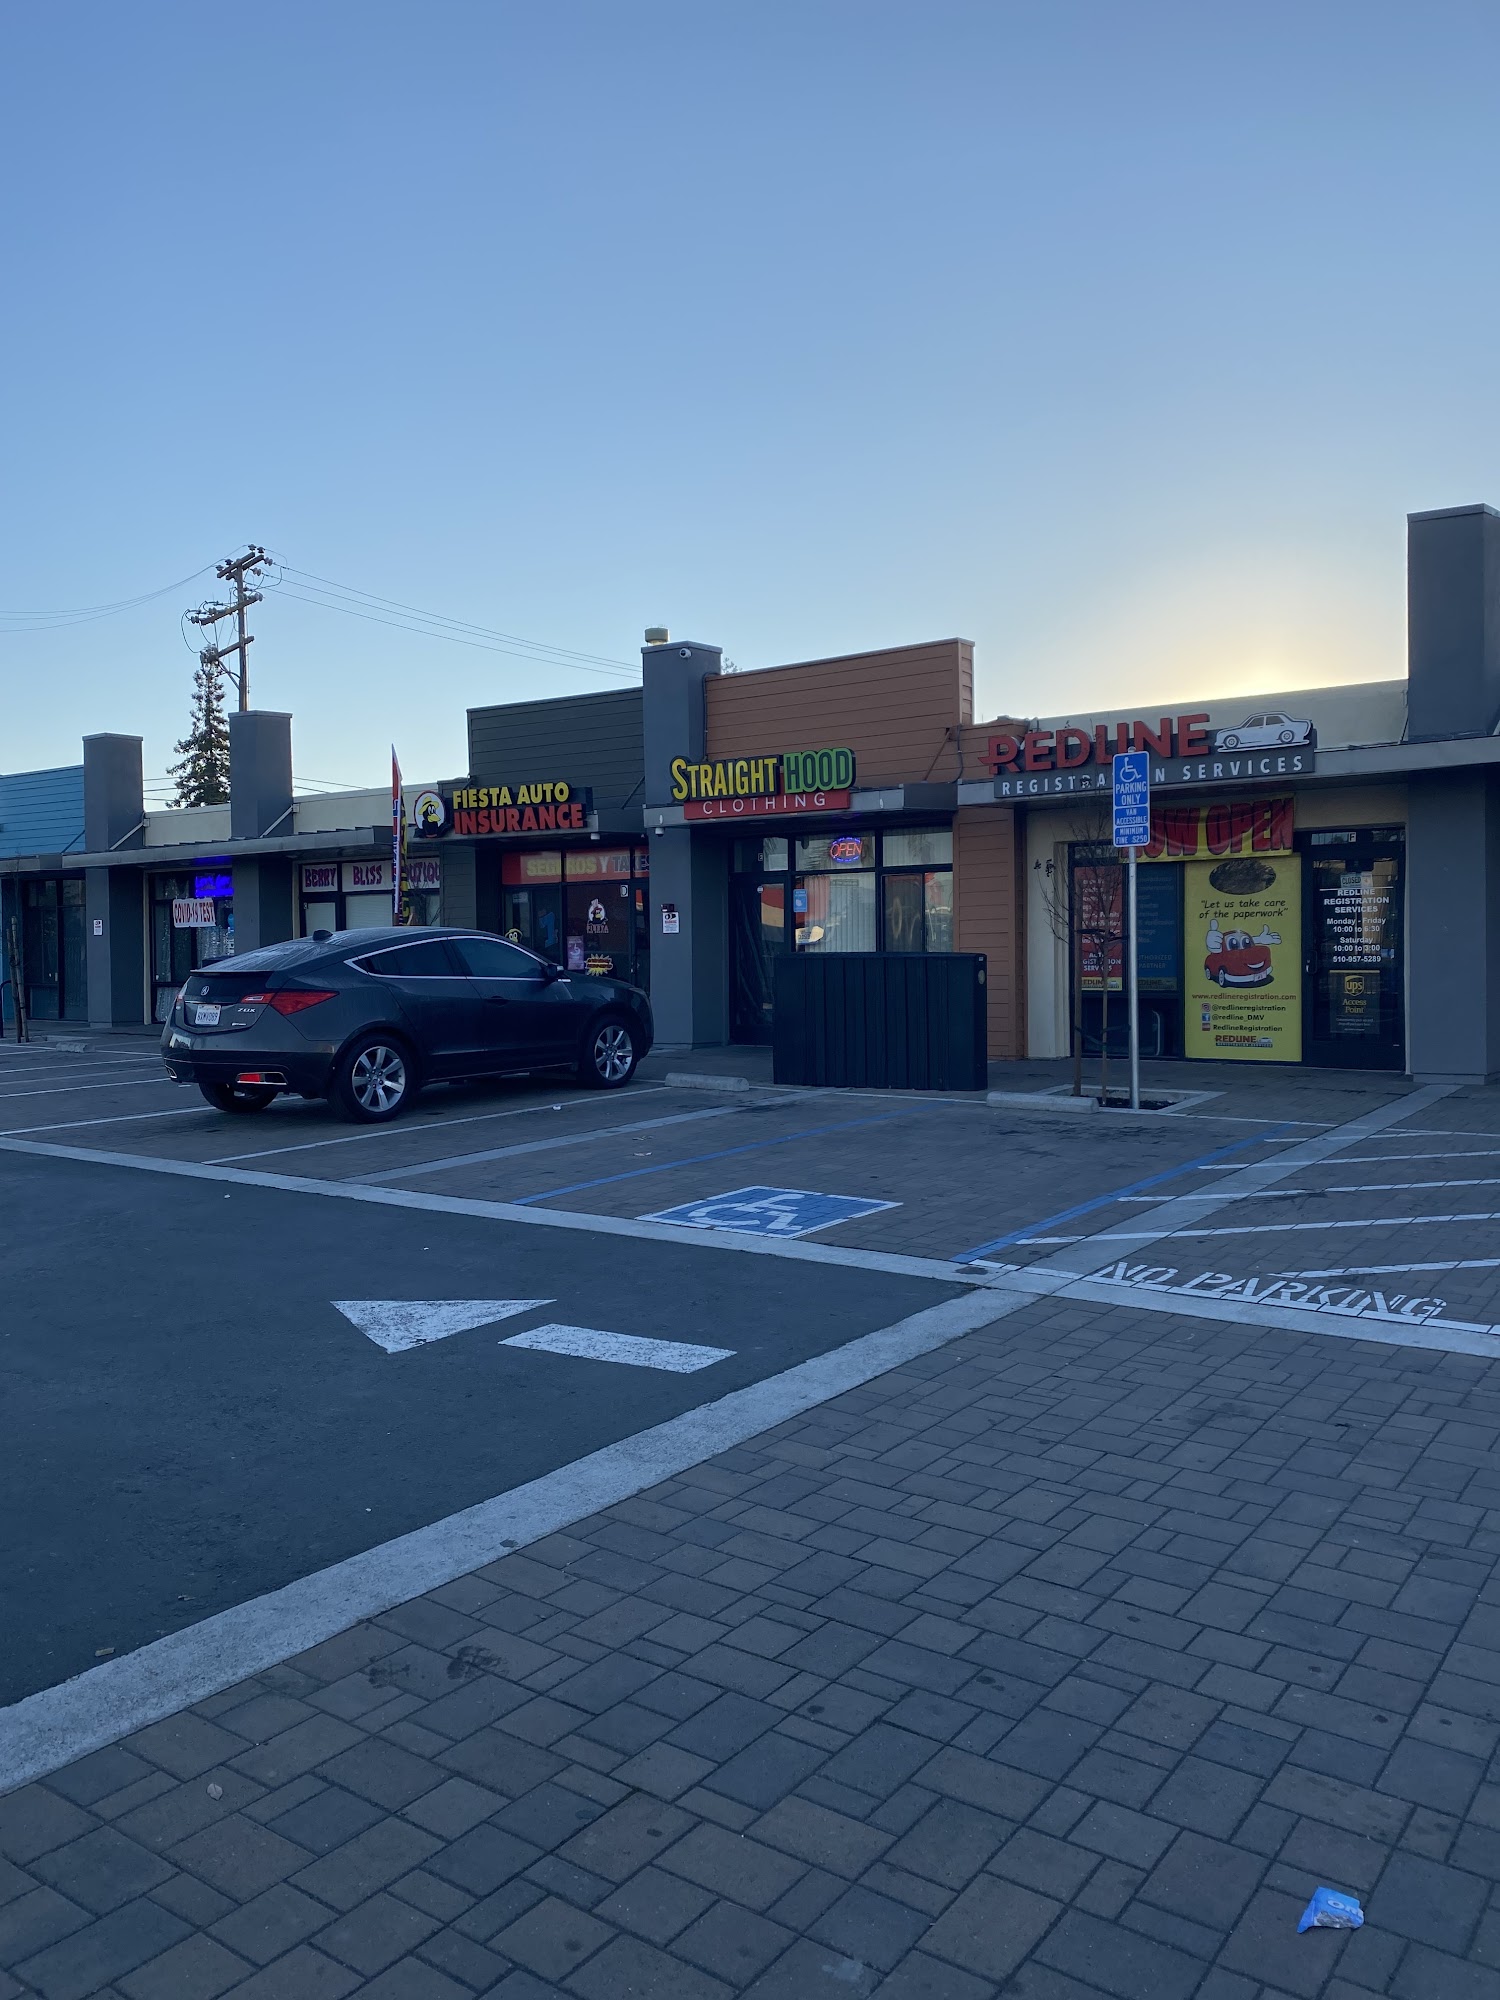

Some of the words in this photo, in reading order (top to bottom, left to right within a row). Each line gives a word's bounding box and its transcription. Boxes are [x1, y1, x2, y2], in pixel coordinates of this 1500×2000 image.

[978, 713, 1209, 775] REDLINE
[1183, 755, 1304, 781] SERVICES
[671, 758, 777, 800] STRAIGHT
[783, 748, 854, 793] HOOD
[1116, 781, 1147, 795] PARKING
[453, 786, 512, 809] FIESTA
[517, 782, 570, 804] AUTO
[1121, 794, 1141, 805] ONLY
[703, 793, 826, 815] CLOTHING
[1126, 808, 1137, 816] VAN
[455, 804, 584, 835] INSURANCE
[1116, 816, 1147, 825] ACCESSIBLE
[1119, 826, 1144, 836] MINIMUM
[1120, 808, 1201, 858] OW
[1205, 798, 1294, 855] OPEN
[1115, 836, 1129, 844] FINE
[831, 843, 862, 858] OPEN
[600, 857, 609, 873] Y
[305, 867, 336, 887] BERRY
[353, 865, 382, 886] BLISS
[1239, 899, 1260, 908] take
[1264, 899, 1286, 907] care
[1324, 897, 1390, 905] REGISTRATION
[1199, 910, 1210, 919] of
[1327, 918, 1356, 926] Monday
[1363, 917, 1387, 925] Friday
[1346, 982, 1362, 994] ups
[1192, 993, 1297, 1001] www.redlineregistration.com
[1212, 1004, 1286, 1012] @redlineregistration
[1212, 1014, 1265, 1022] @redline_DMV
[1213, 1024, 1283, 1032] RedlineRegistration
[1215, 1035, 1257, 1043] REDLINE
[1097, 1261, 1179, 1284] NO
[1183, 1272, 1447, 1317] PARKING
